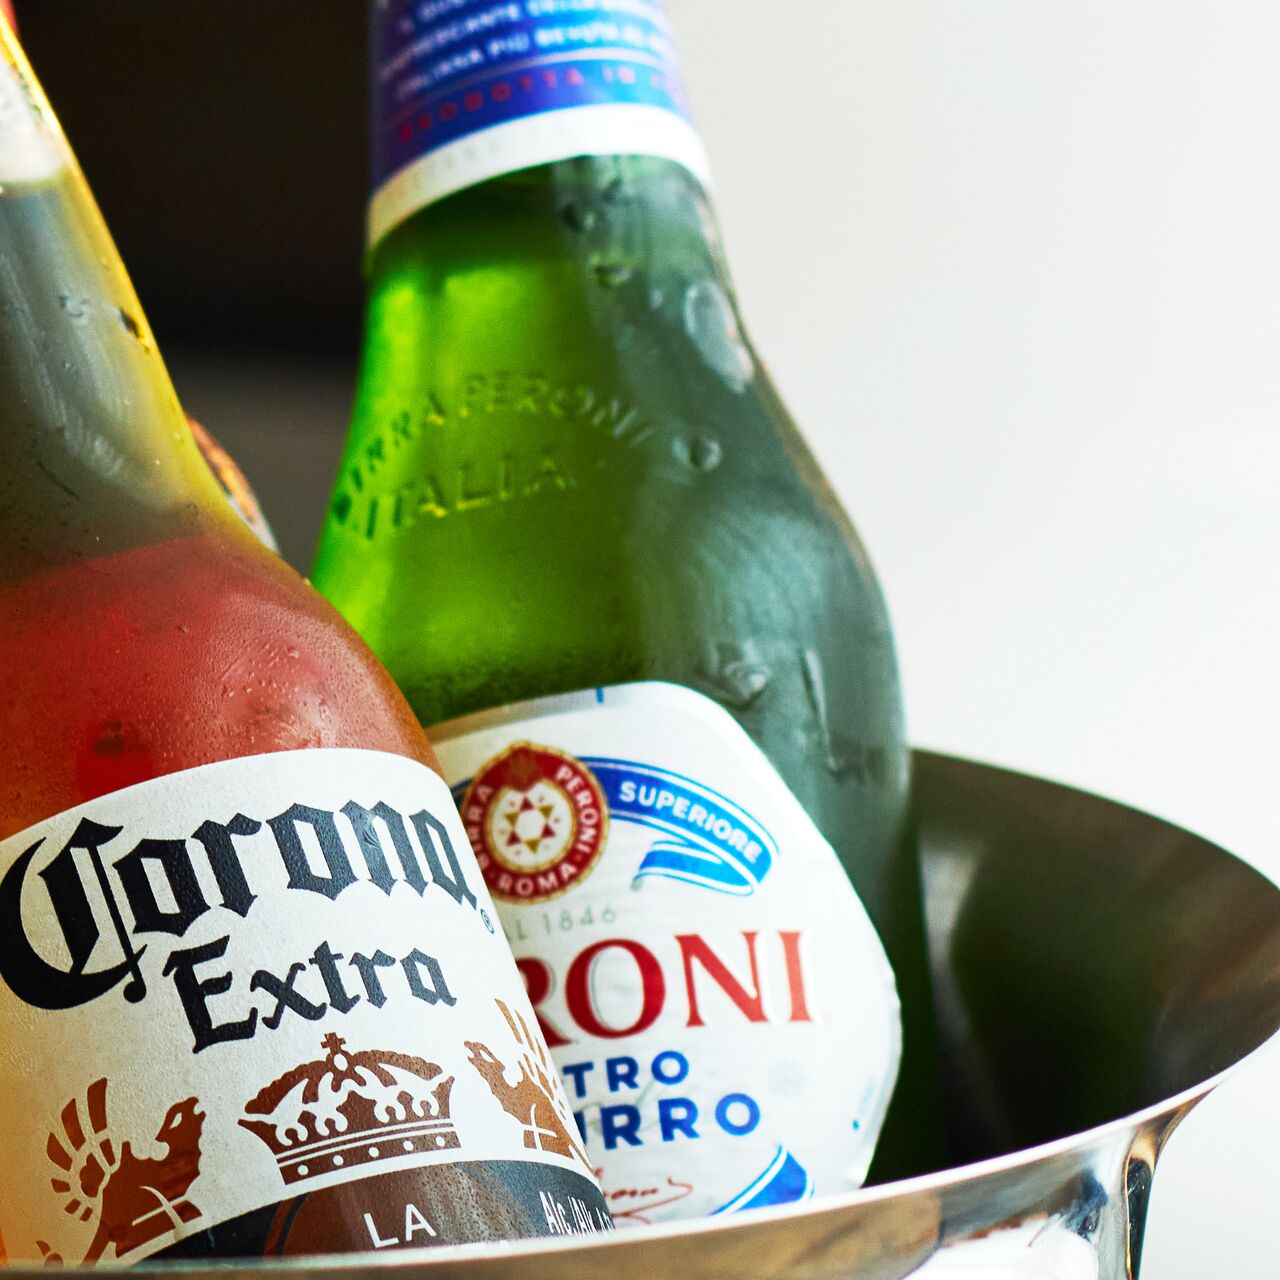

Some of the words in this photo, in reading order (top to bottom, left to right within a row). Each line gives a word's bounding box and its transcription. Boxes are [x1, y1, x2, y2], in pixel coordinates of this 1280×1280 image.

[555, 764, 599, 854] PERONI
[619, 780, 762, 864] SUPERIORE
[496, 862, 578, 897] ROMA
[542, 905, 617, 935] 1846
[162, 935, 458, 1055] Extra
[514, 931, 816, 1048] RONI
[562, 1050, 690, 1099] TRO
[363, 1203, 437, 1249] LA
